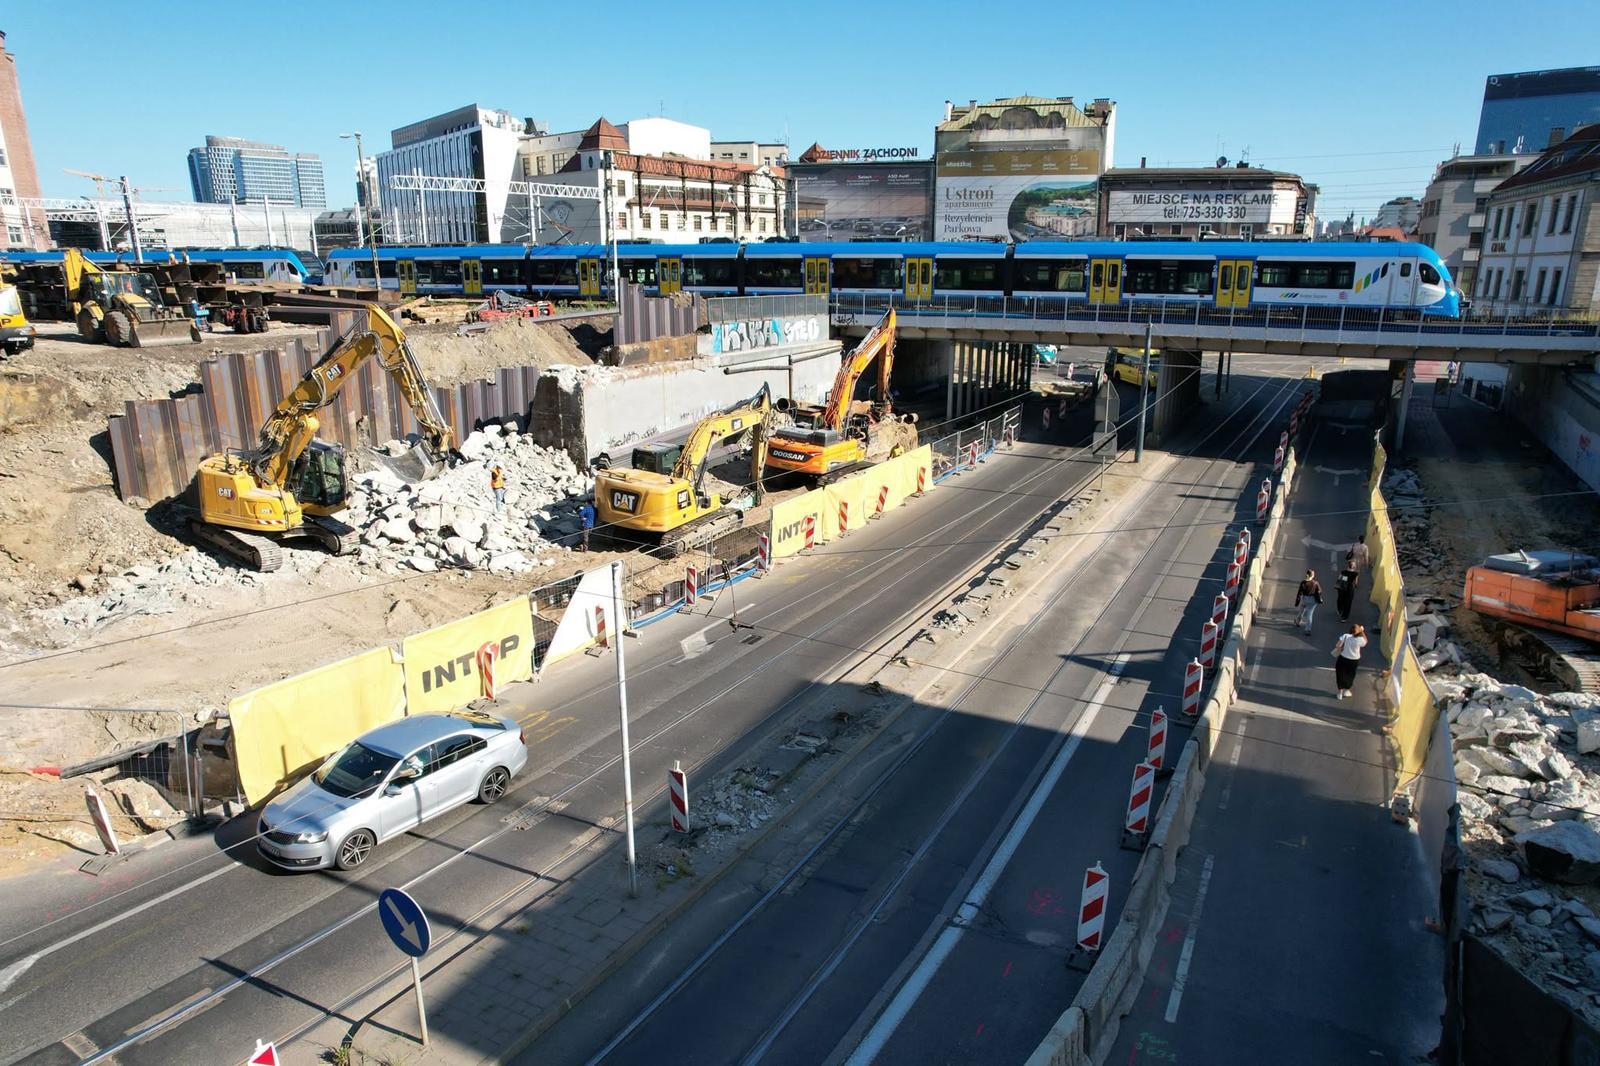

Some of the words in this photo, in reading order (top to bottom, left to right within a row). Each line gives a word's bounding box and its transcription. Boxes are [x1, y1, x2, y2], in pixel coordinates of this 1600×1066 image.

[814, 149, 861, 160] DZIENNIK
[863, 147, 918, 159] ZACHODNI
[945, 185, 994, 201] Ustroń
[944, 200, 993, 209] apartamenty
[1133, 194, 1189, 205] MIEJSCE
[1192, 194, 1210, 204] NA
[1163, 206, 1180, 218] tel:
[1183, 206, 1247, 219] 725-330-330
[944, 213, 993, 225] Rezydencja
[944, 224, 982, 233] Parkowa
[326, 364, 342, 381] CAT
[773, 449, 805, 461] DOOSAN
[218, 487, 232, 498] CAT
[613, 492, 635, 511] CAT
